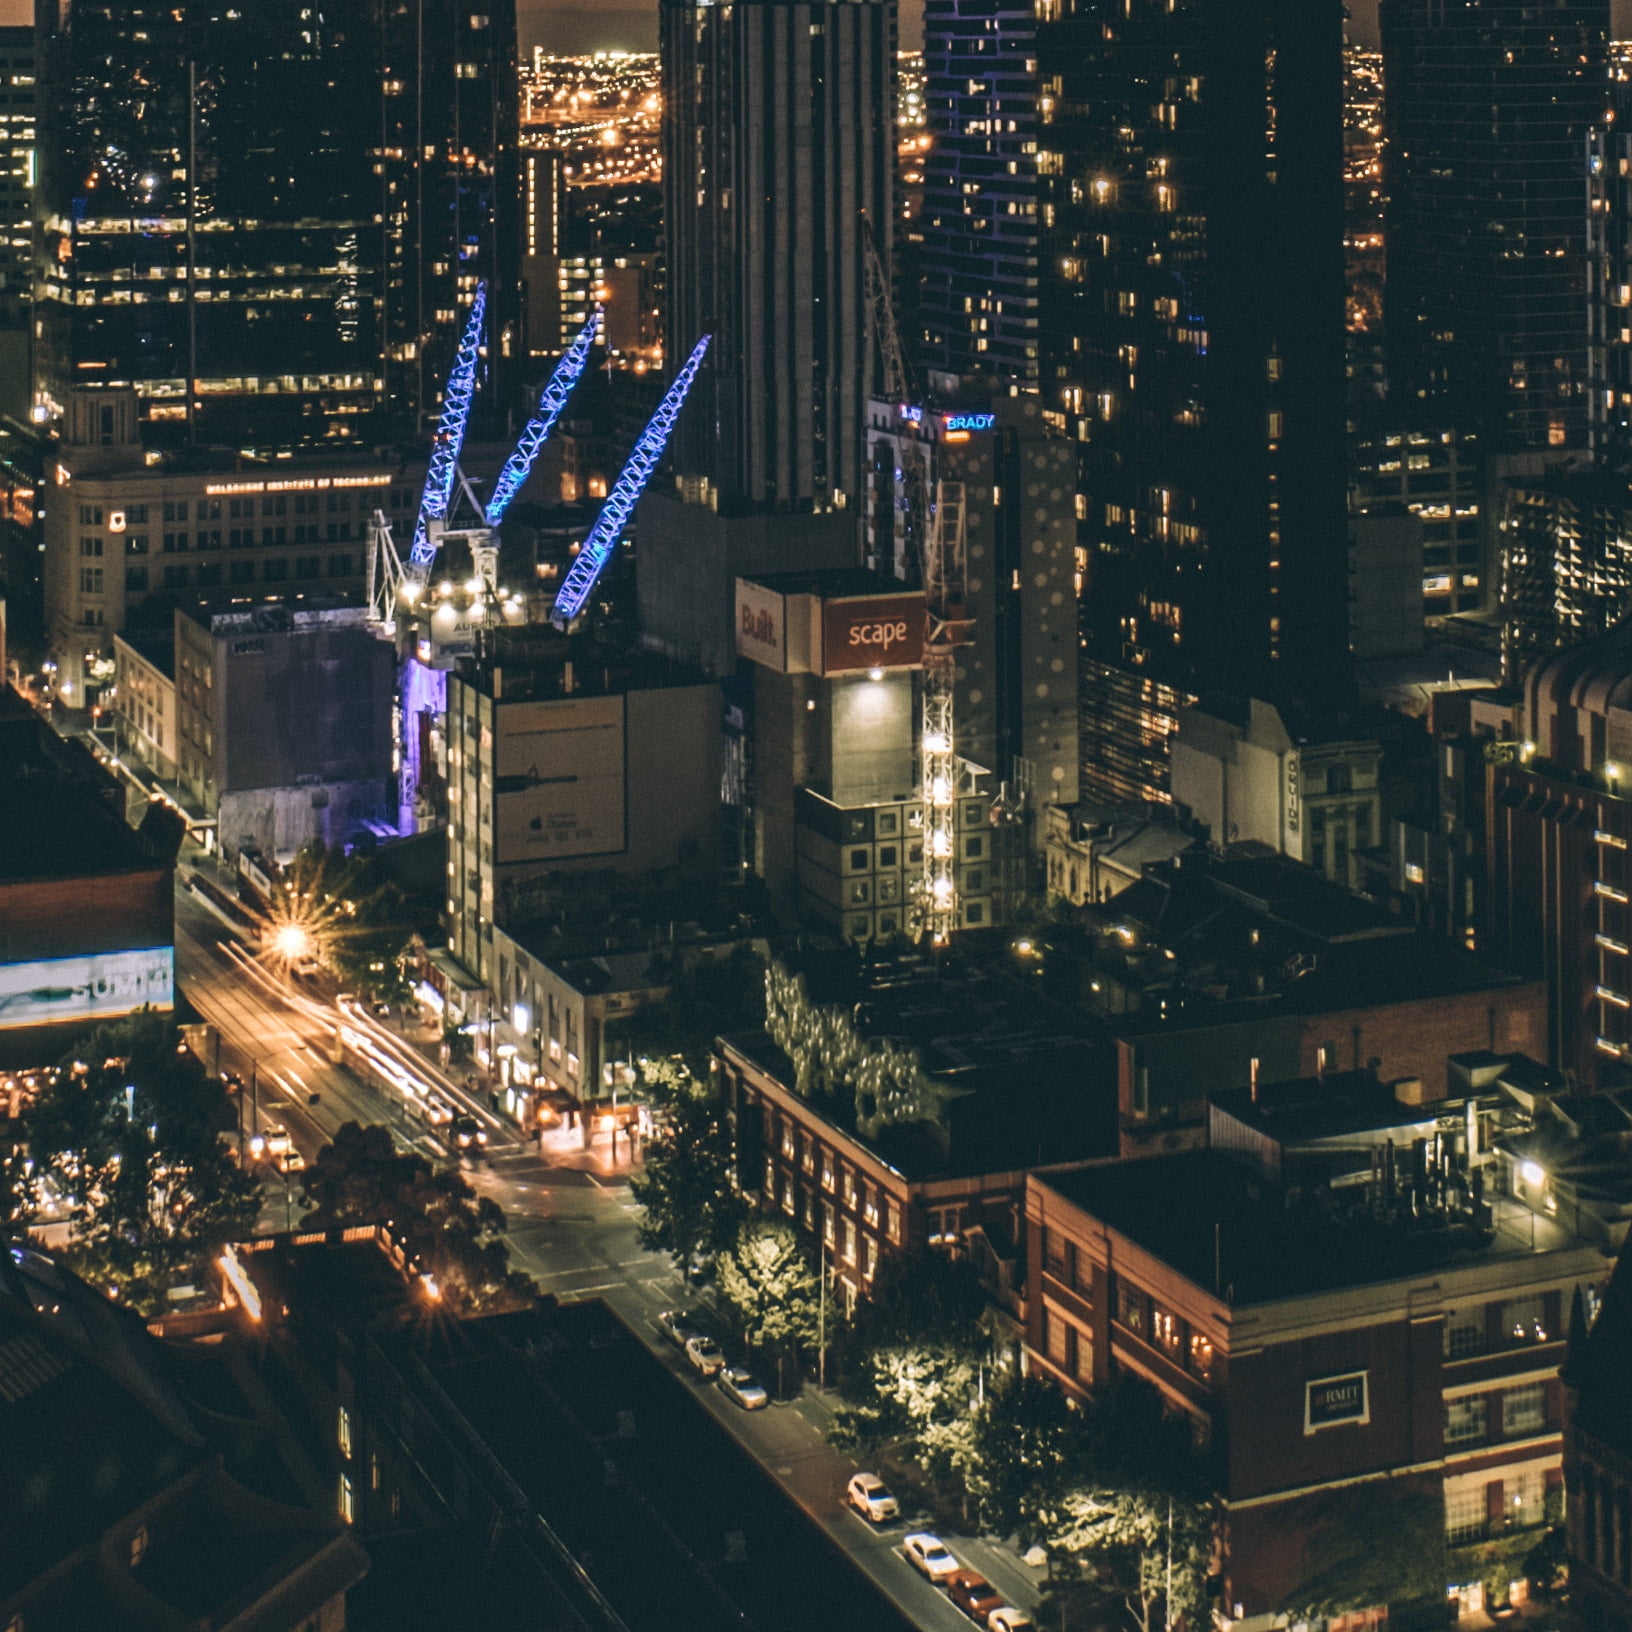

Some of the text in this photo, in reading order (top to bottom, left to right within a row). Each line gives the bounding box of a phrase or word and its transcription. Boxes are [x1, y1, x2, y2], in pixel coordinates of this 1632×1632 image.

[946, 414, 995, 430] BRADY
[848, 621, 908, 651] scape
[1325, 1385, 1359, 1404] RMIT
